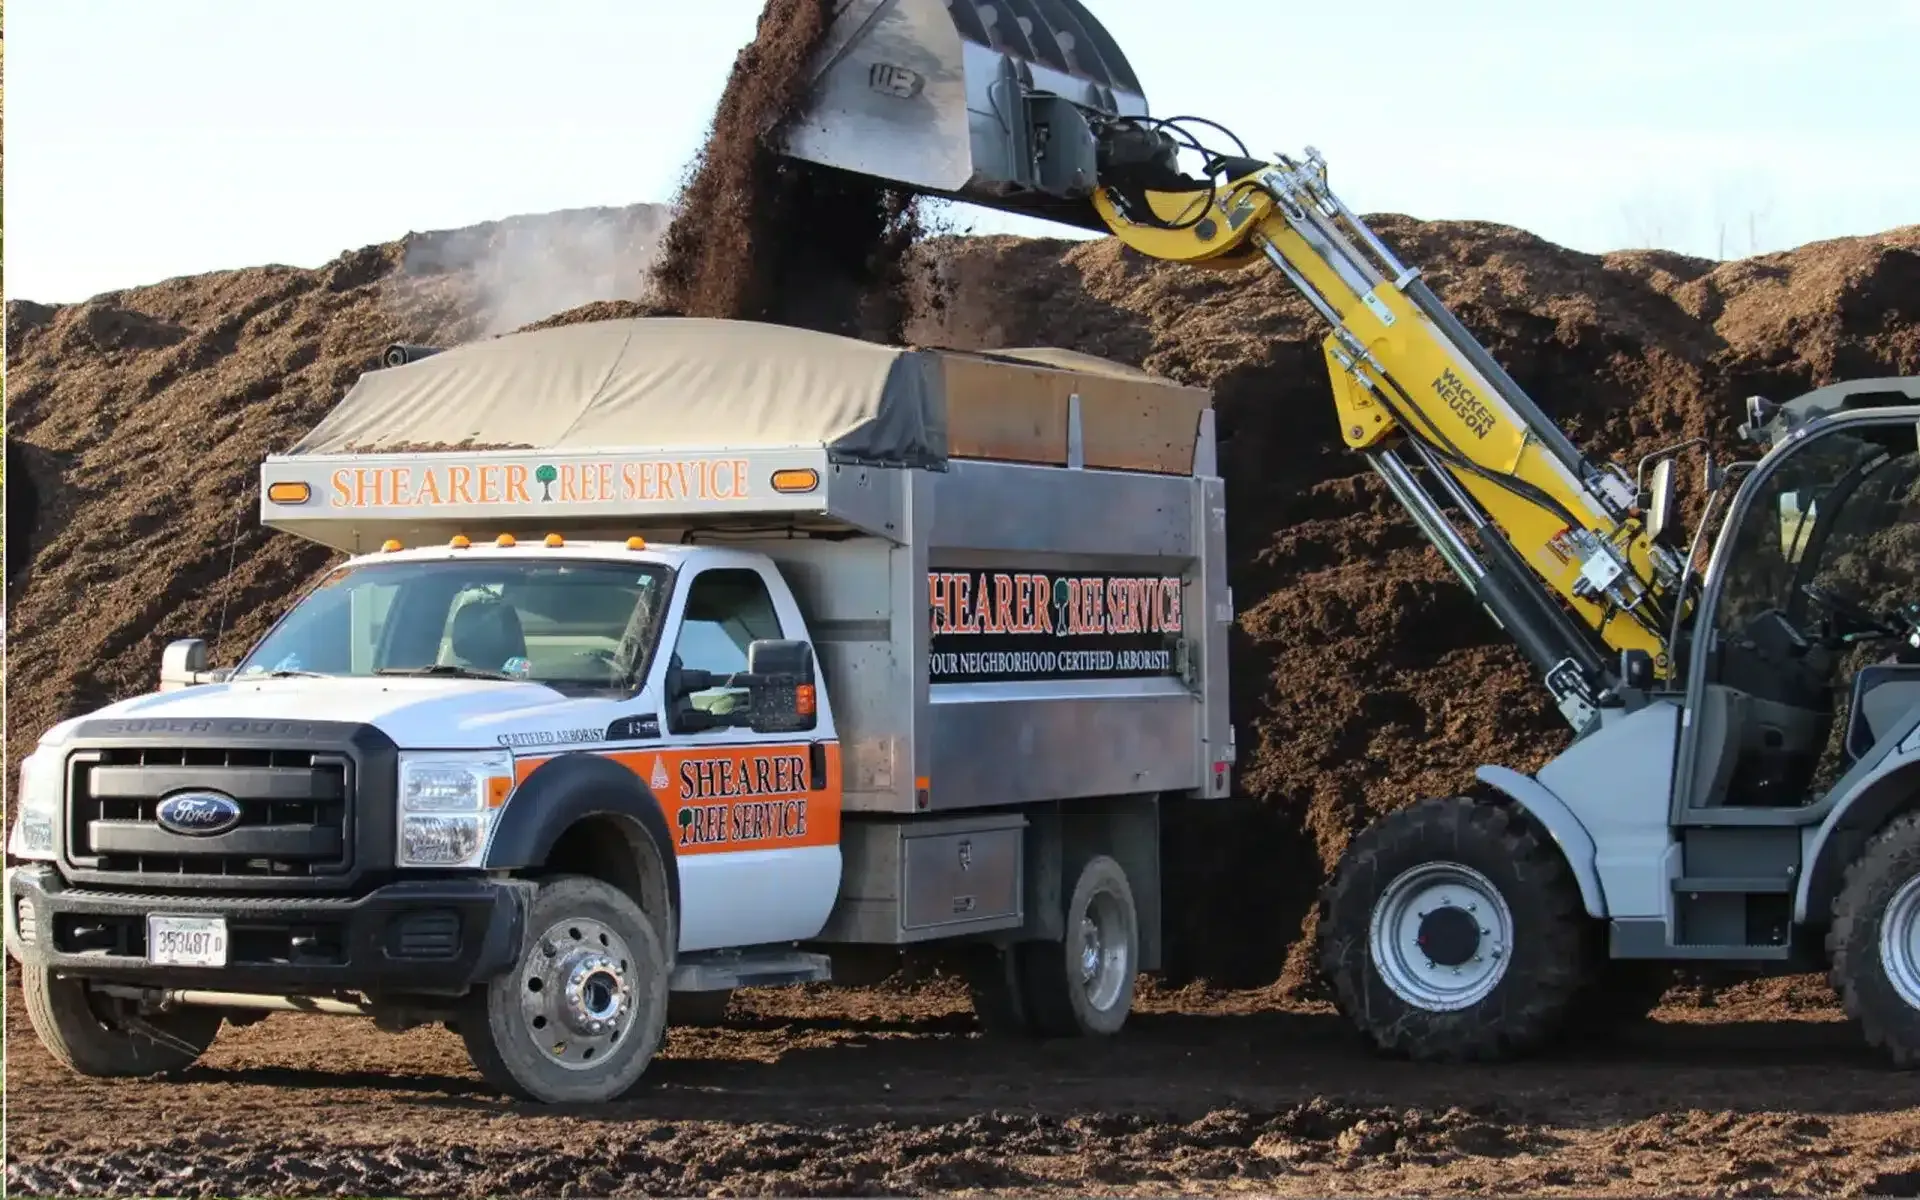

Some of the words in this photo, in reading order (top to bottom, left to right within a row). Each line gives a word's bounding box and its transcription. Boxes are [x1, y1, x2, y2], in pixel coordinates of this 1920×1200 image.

[1431, 377, 1489, 440] NEUSON
[1442, 367, 1496, 430] WACKER
[331, 464, 532, 508] SHEARER
[621, 458, 750, 501] SERVICE
[928, 573, 1053, 634] HEARER
[1107, 577, 1181, 633] SERVICE
[960, 651, 1056, 673] NEIGHBORHOOD
[1057, 650, 1114, 671] CERTIFIED
[497, 731, 553, 747] CERTIFIED
[555, 728, 605, 744] ARBORIST
[680, 755, 808, 800] SHEARER
[172, 799, 218, 823] Ford
[731, 798, 808, 841] SERVICE
[159, 931, 211, 955] 353487
